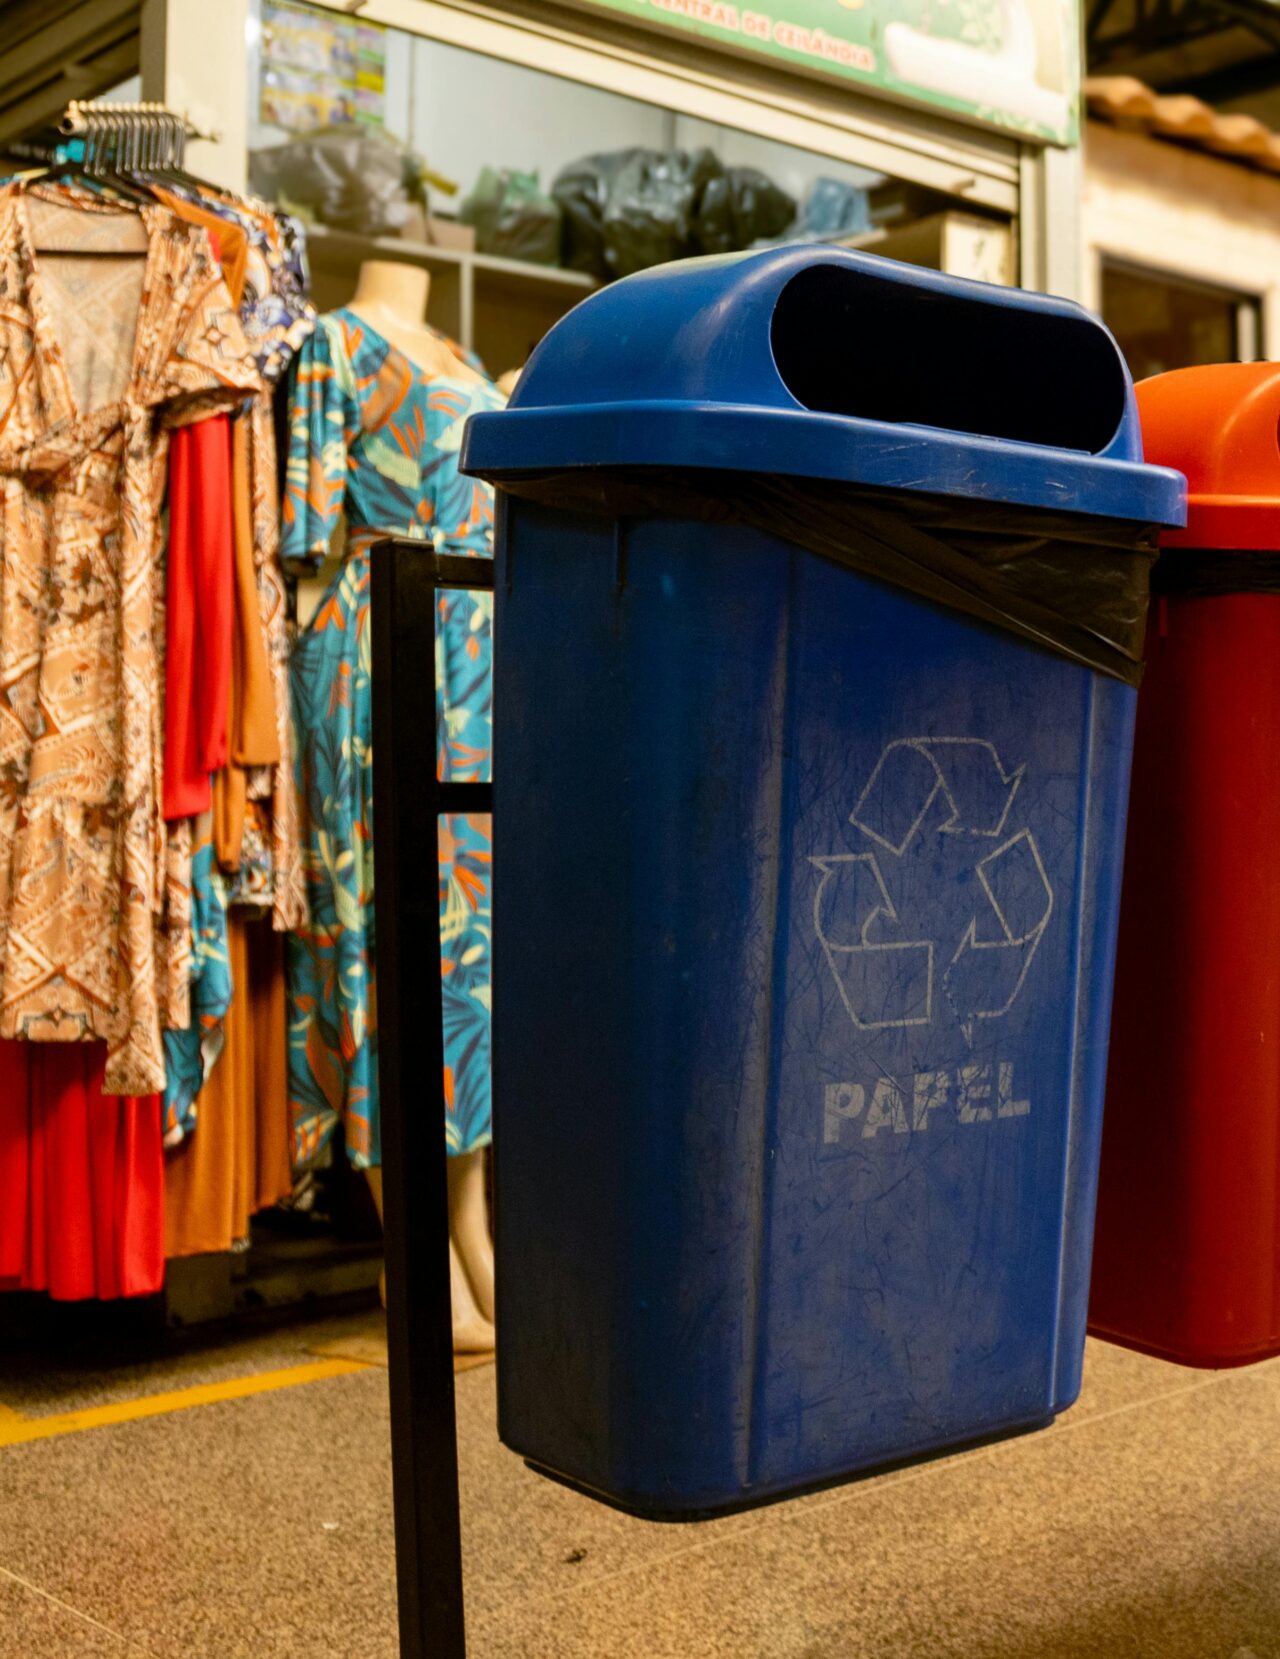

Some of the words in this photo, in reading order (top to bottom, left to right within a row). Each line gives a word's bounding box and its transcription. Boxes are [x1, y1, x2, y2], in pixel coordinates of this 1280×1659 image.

[651, 0, 738, 30] NTRAL
[742, 10, 769, 40] DE
[823, 1062, 1031, 1144] PAPEL
